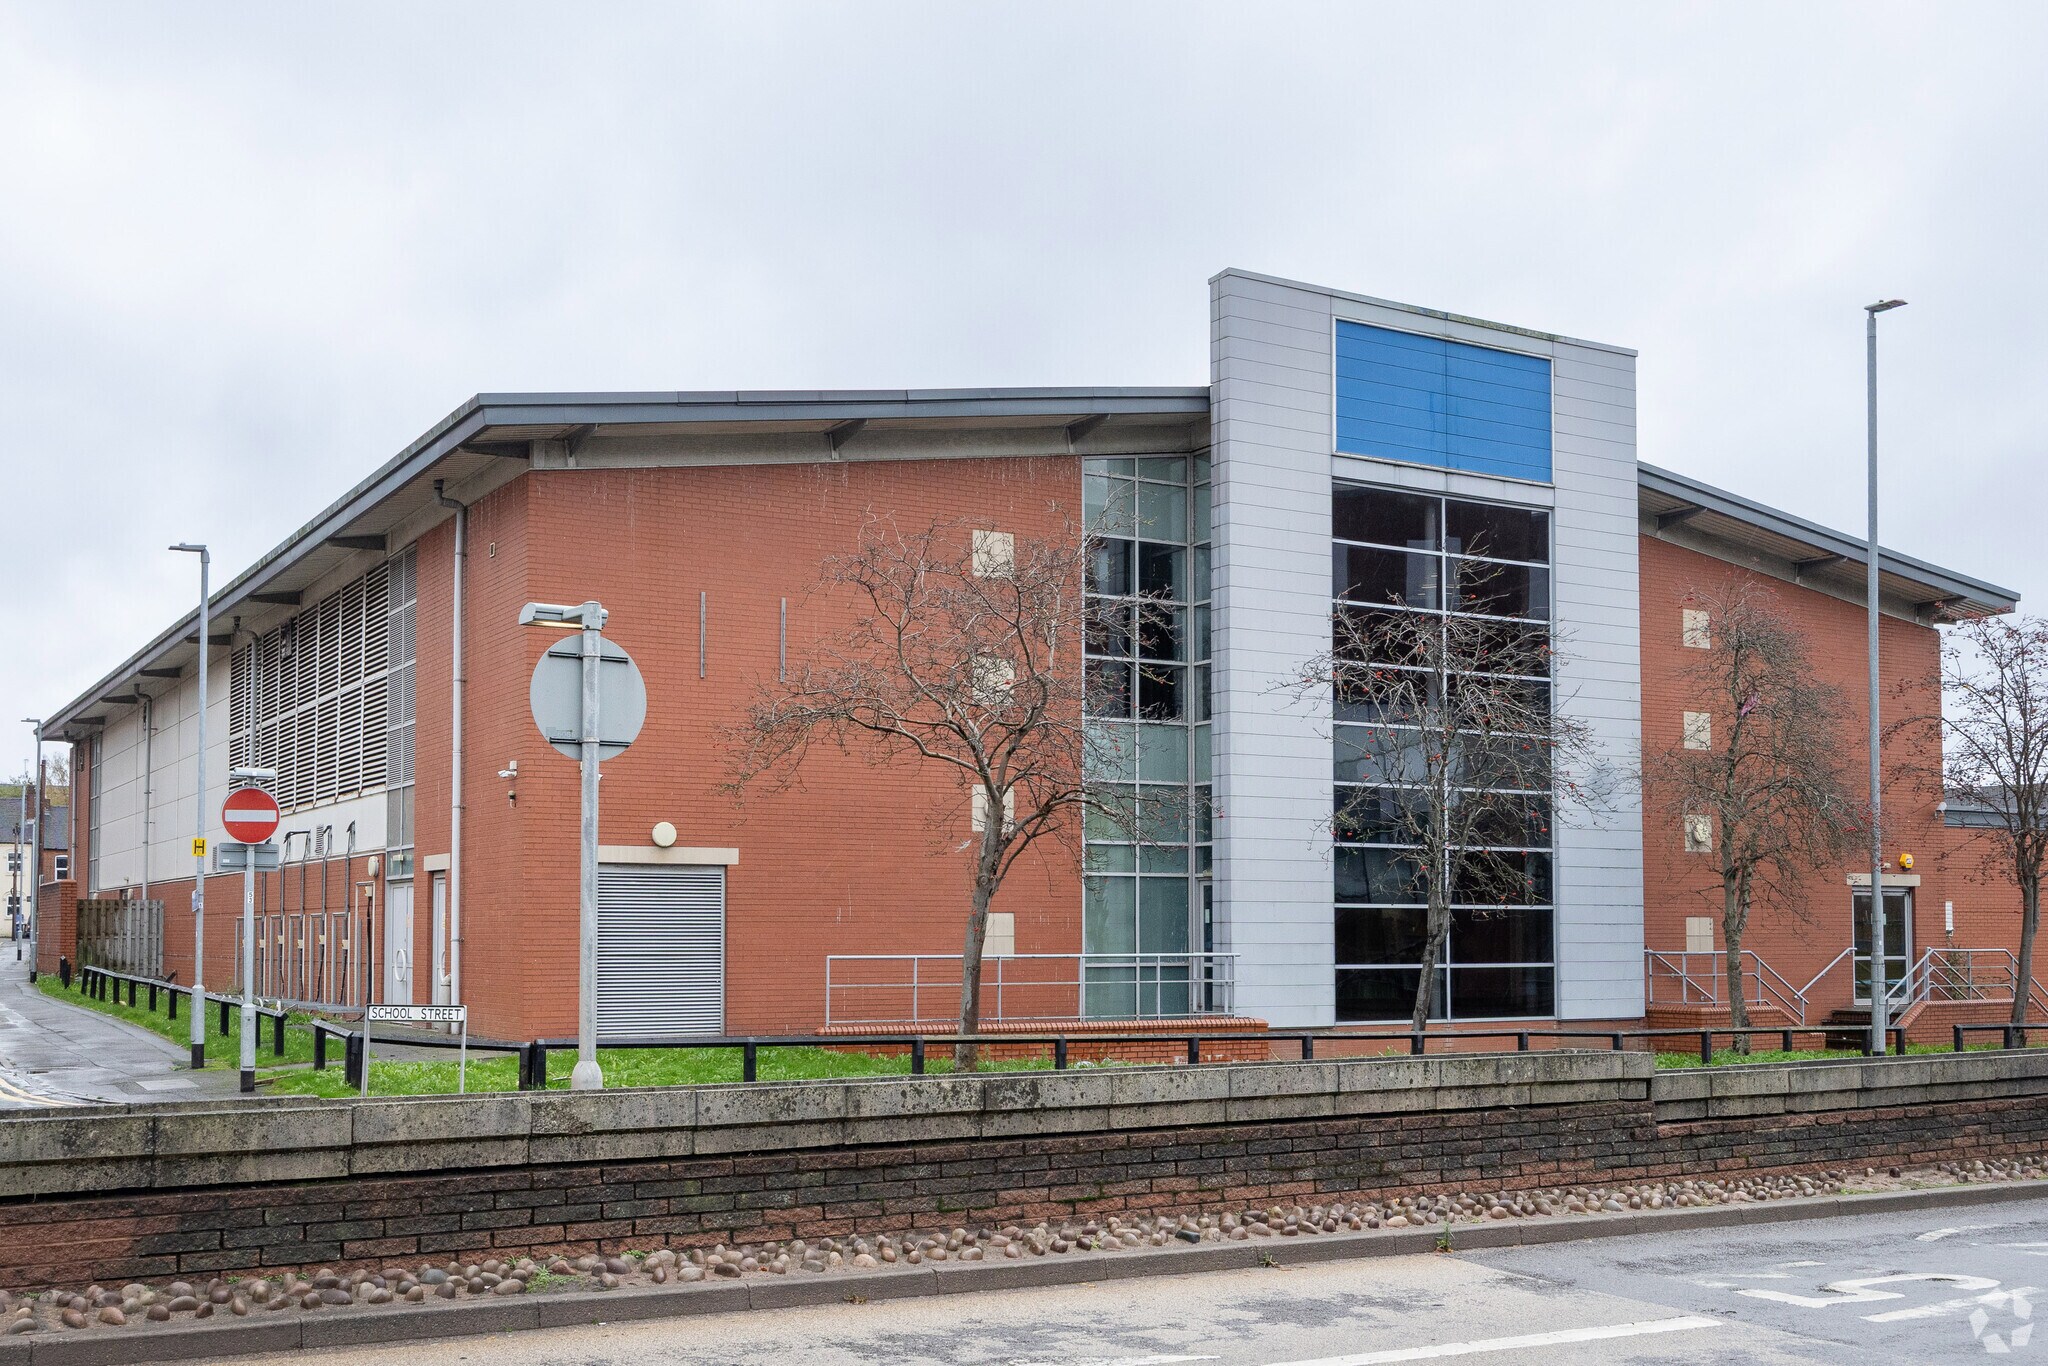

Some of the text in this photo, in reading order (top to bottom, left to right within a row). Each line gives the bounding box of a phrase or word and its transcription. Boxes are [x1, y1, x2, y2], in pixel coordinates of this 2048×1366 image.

[194, 839, 204, 855] H
[371, 1007, 462, 1020] SCHOOL STREET
